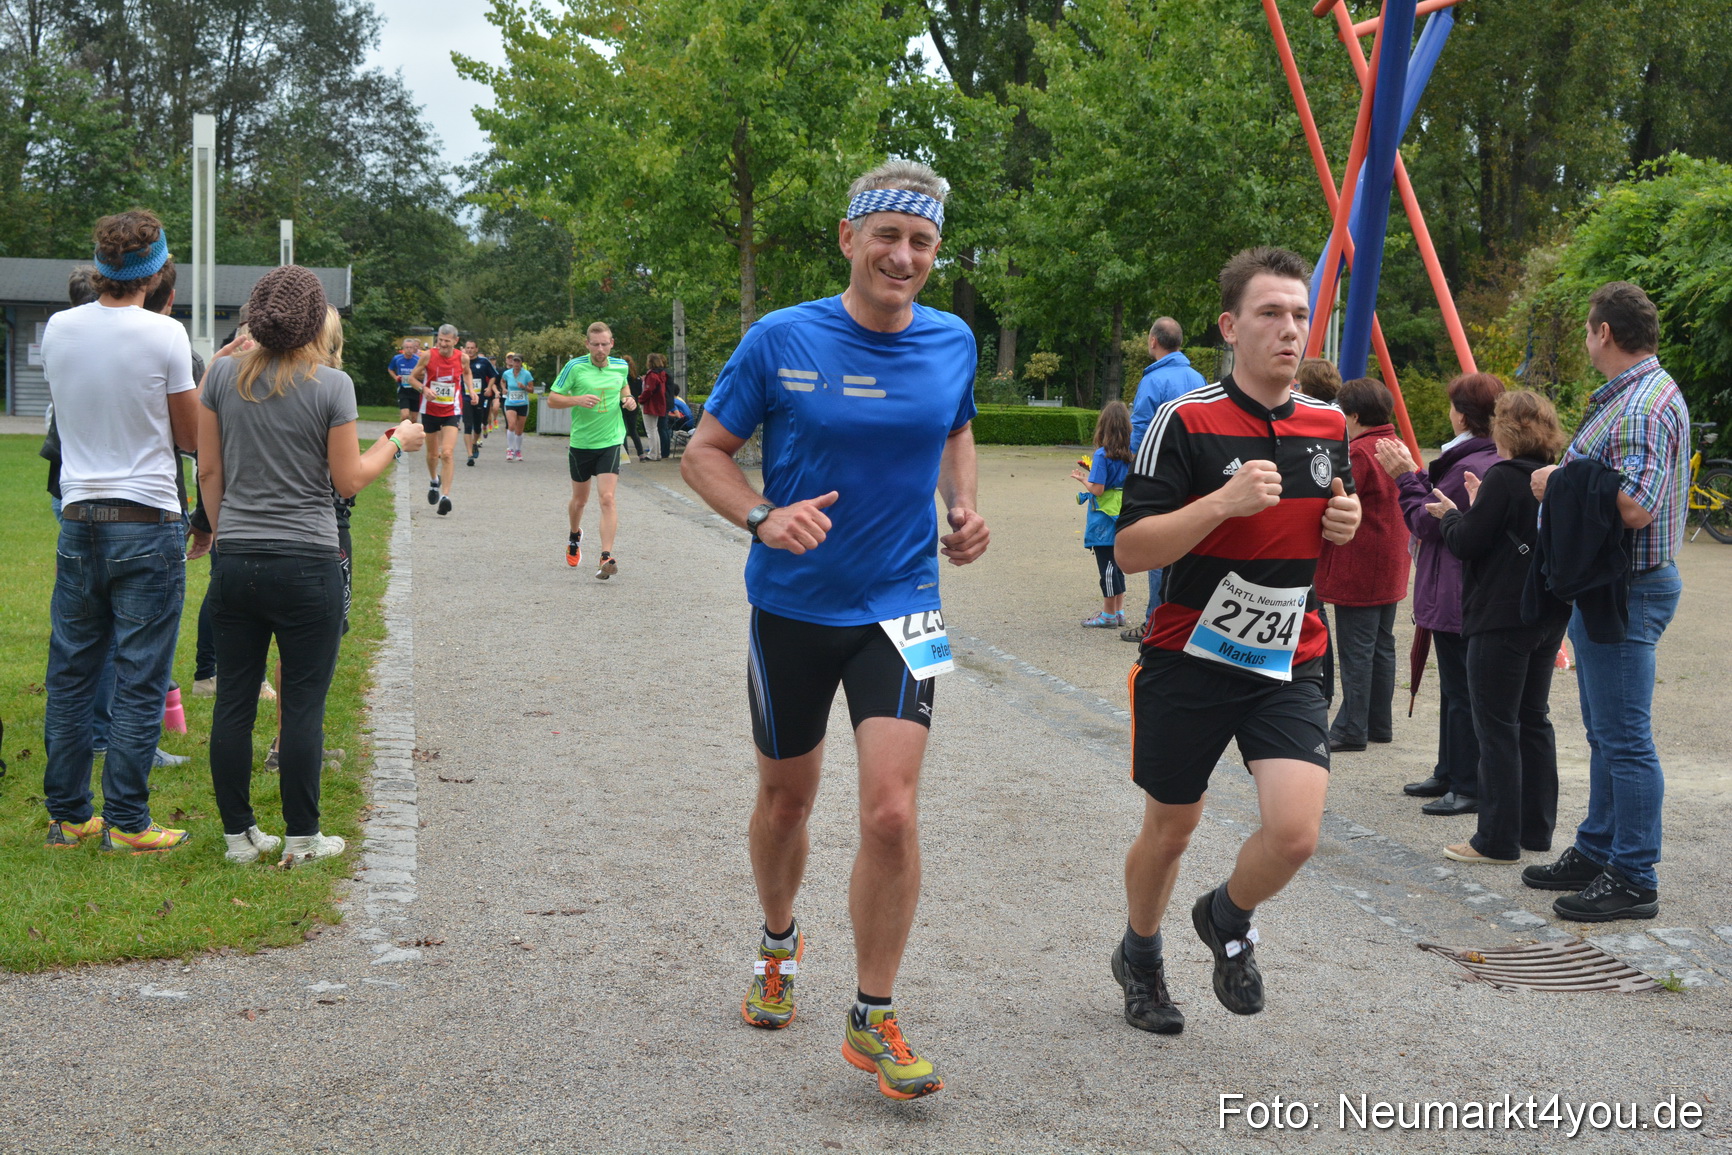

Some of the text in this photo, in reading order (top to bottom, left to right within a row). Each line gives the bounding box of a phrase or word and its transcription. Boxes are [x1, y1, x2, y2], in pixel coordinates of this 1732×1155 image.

[435, 386, 450, 396] 244
[1221, 578, 1297, 608] PARTL Neumarkt
[1211, 599, 1297, 646] 2734
[1218, 641, 1267, 665] Markus
